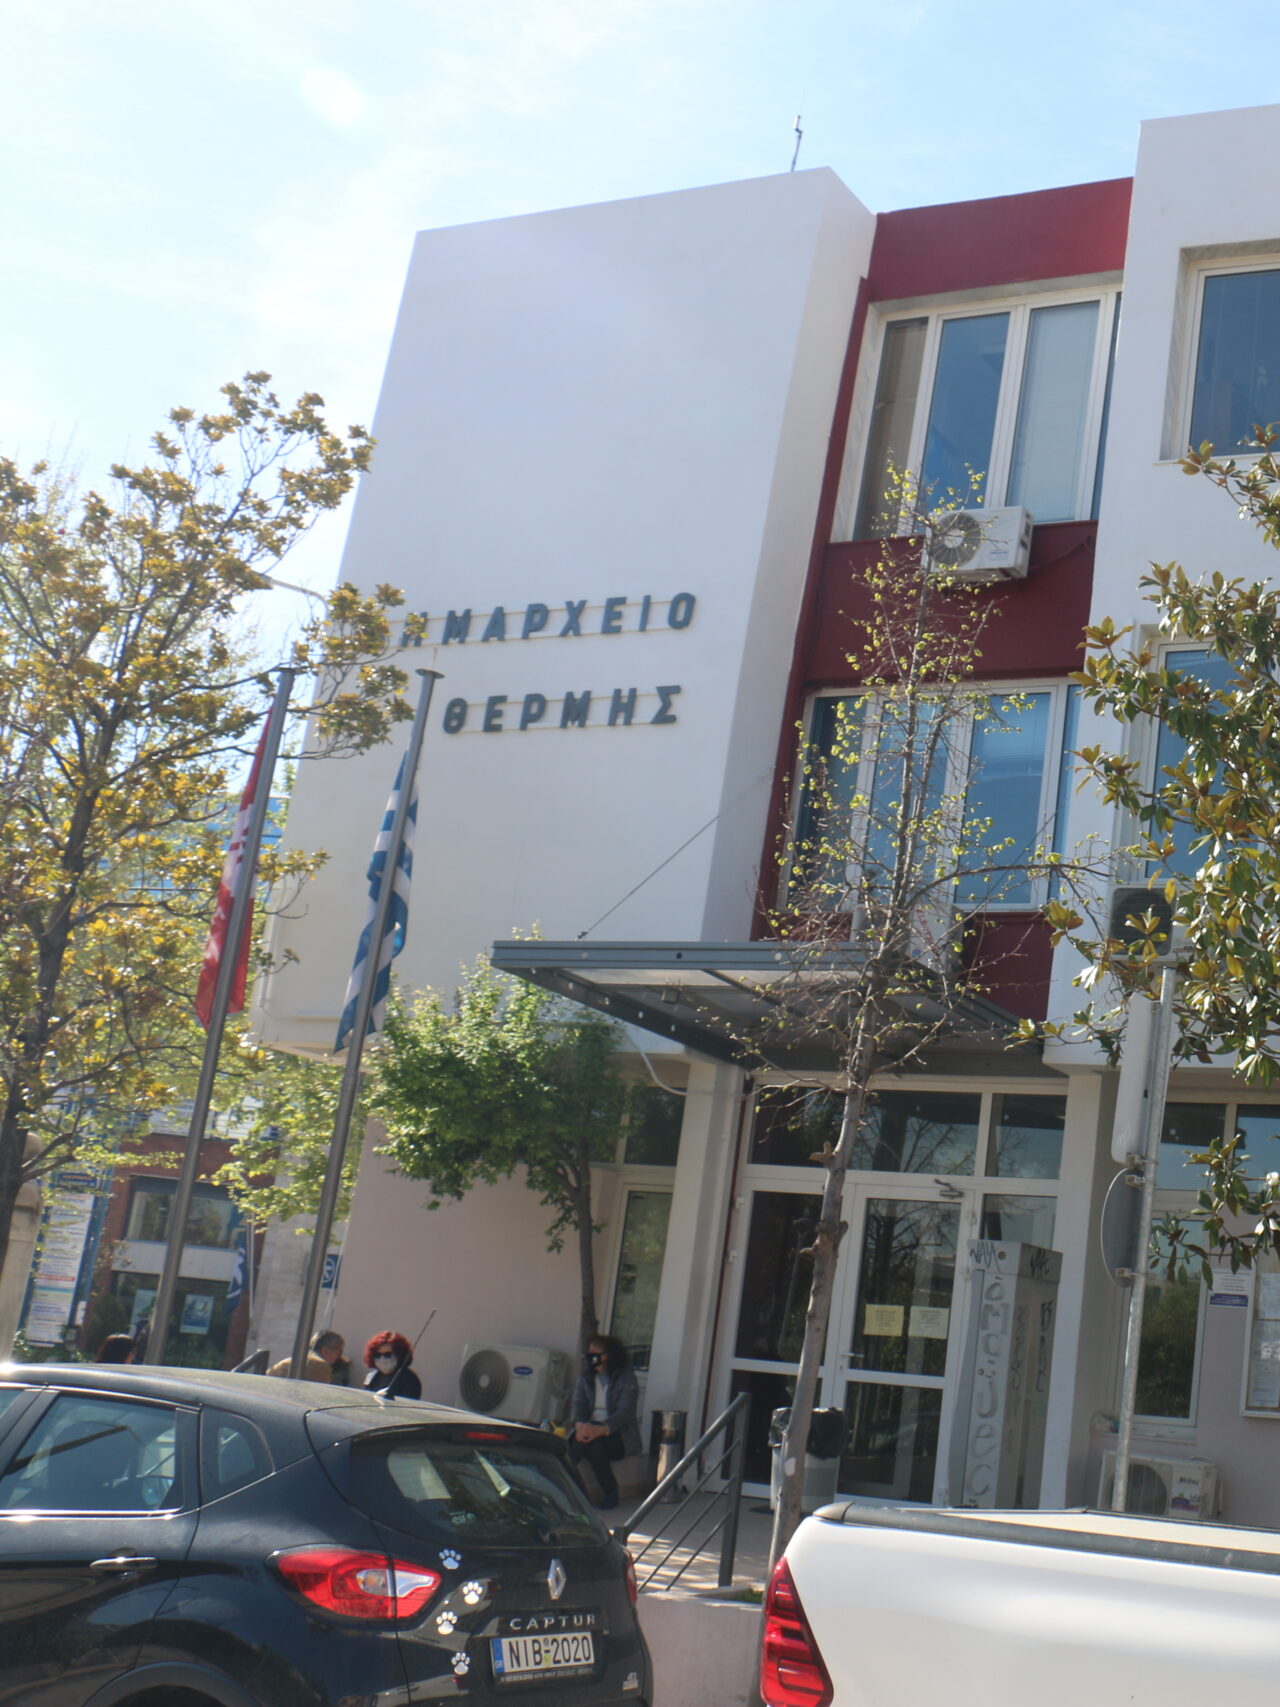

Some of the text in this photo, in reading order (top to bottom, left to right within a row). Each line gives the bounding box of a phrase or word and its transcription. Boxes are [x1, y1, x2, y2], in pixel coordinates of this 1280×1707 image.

[400, 592, 696, 648] ΗΜΑΡΧΕΙΟ
[443, 685, 682, 735] ΘΕΡΜΗΣ
[509, 1613, 596, 1631] CAPTUR
[508, 1635, 592, 1668] NIB-2020
